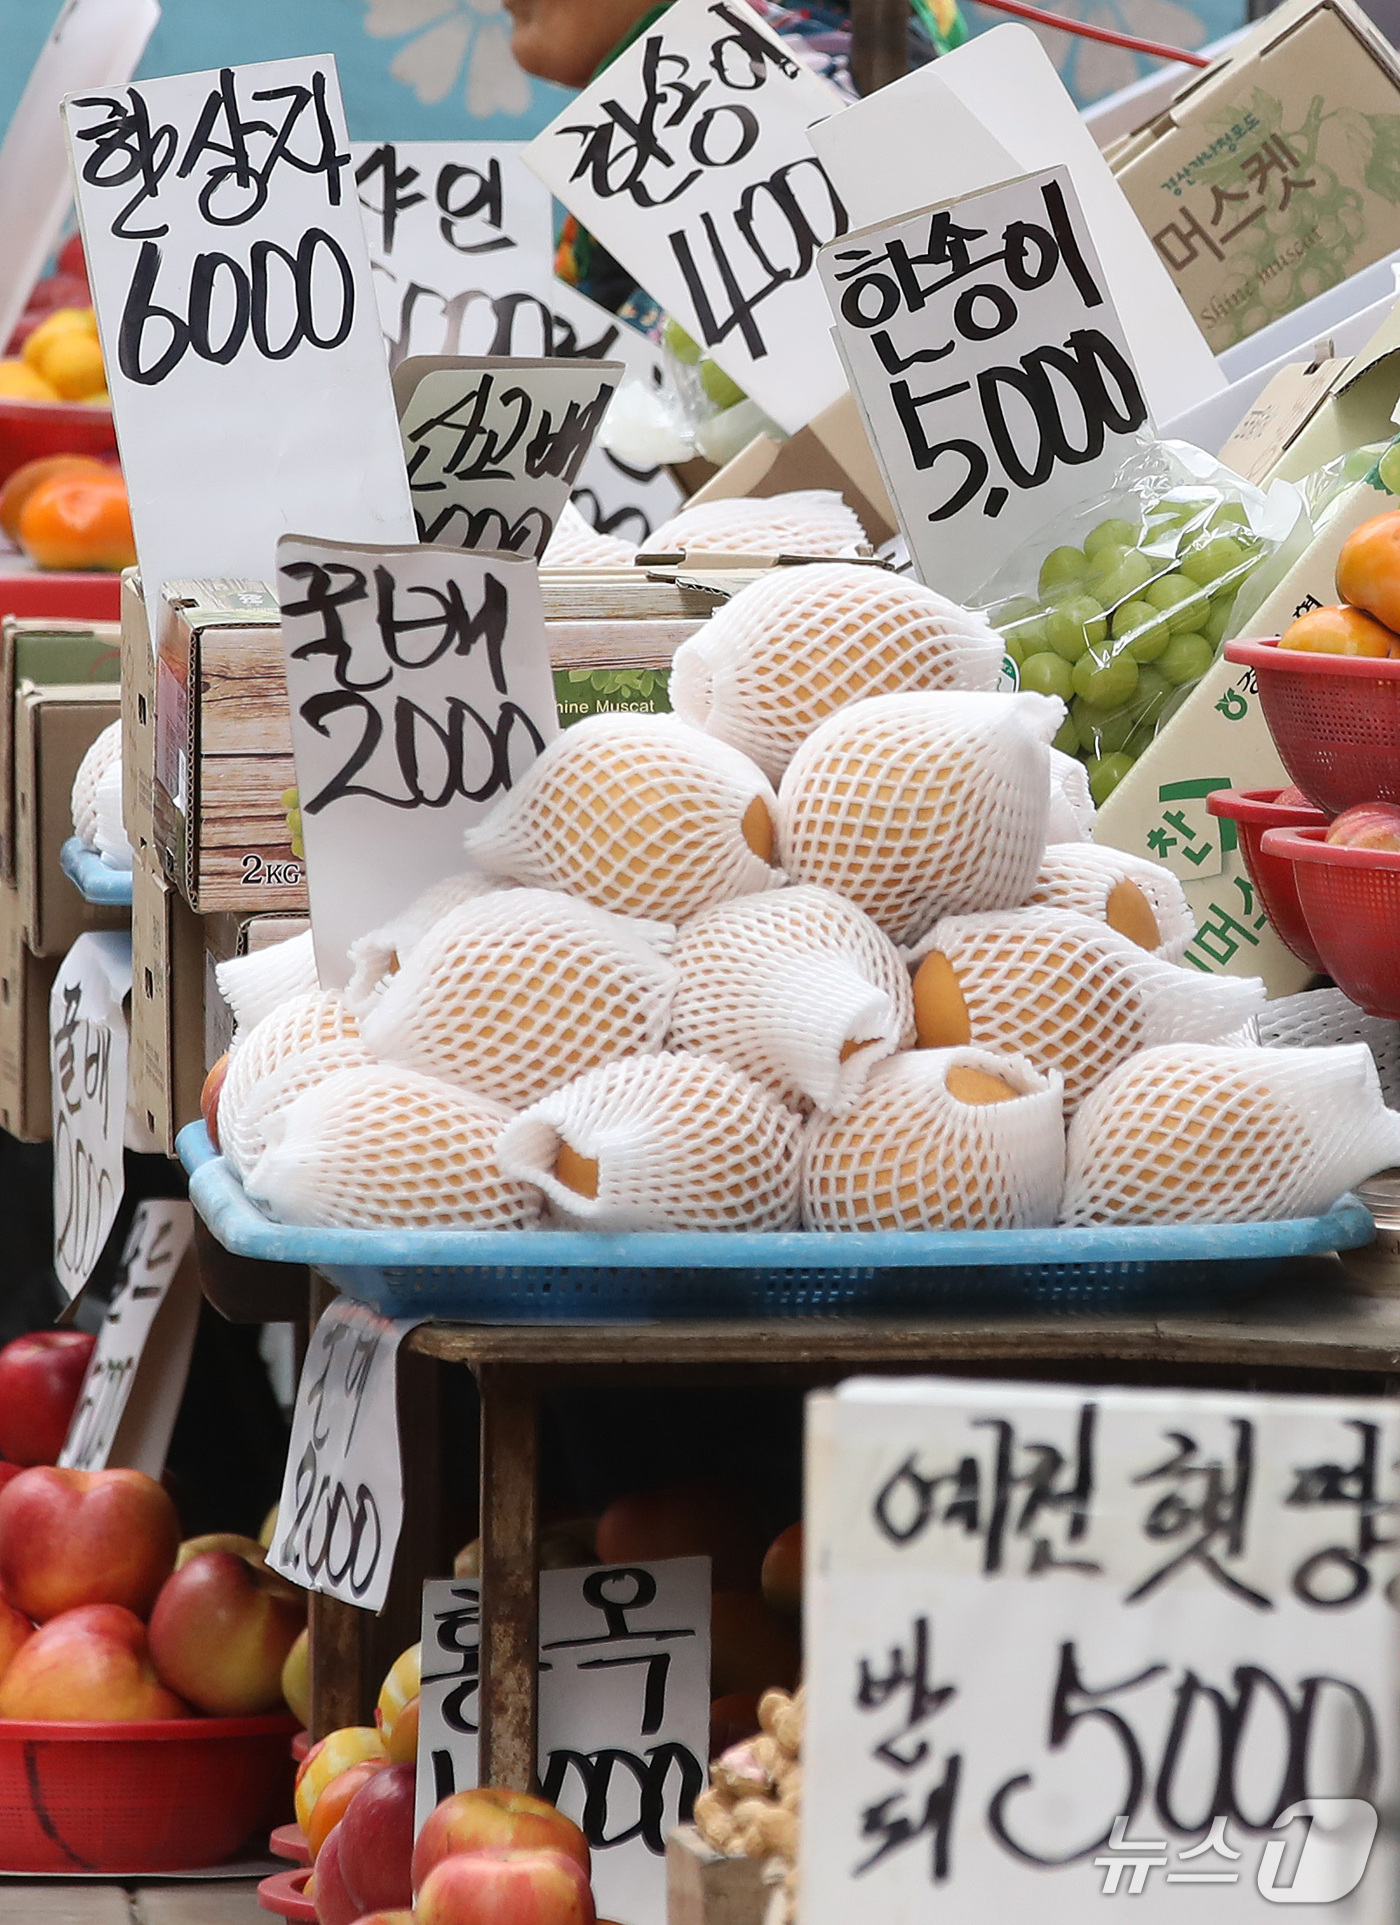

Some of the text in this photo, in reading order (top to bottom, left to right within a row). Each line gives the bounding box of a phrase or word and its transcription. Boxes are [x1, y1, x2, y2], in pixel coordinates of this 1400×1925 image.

[70, 68, 351, 239] 한상자
[555, 2, 801, 208] 한송이
[834, 179, 1104, 375] 한송이
[1152, 131, 1317, 271] 머스켓
[118, 227, 355, 384] 6000
[888, 328, 1148, 522] 5,000
[280, 561, 508, 695] 꿀배
[596, 700, 655, 713] Muscat
[299, 689, 546, 815] 2000
[240, 854, 301, 886] 2KG
[988, 1640, 1376, 1865] 5000
